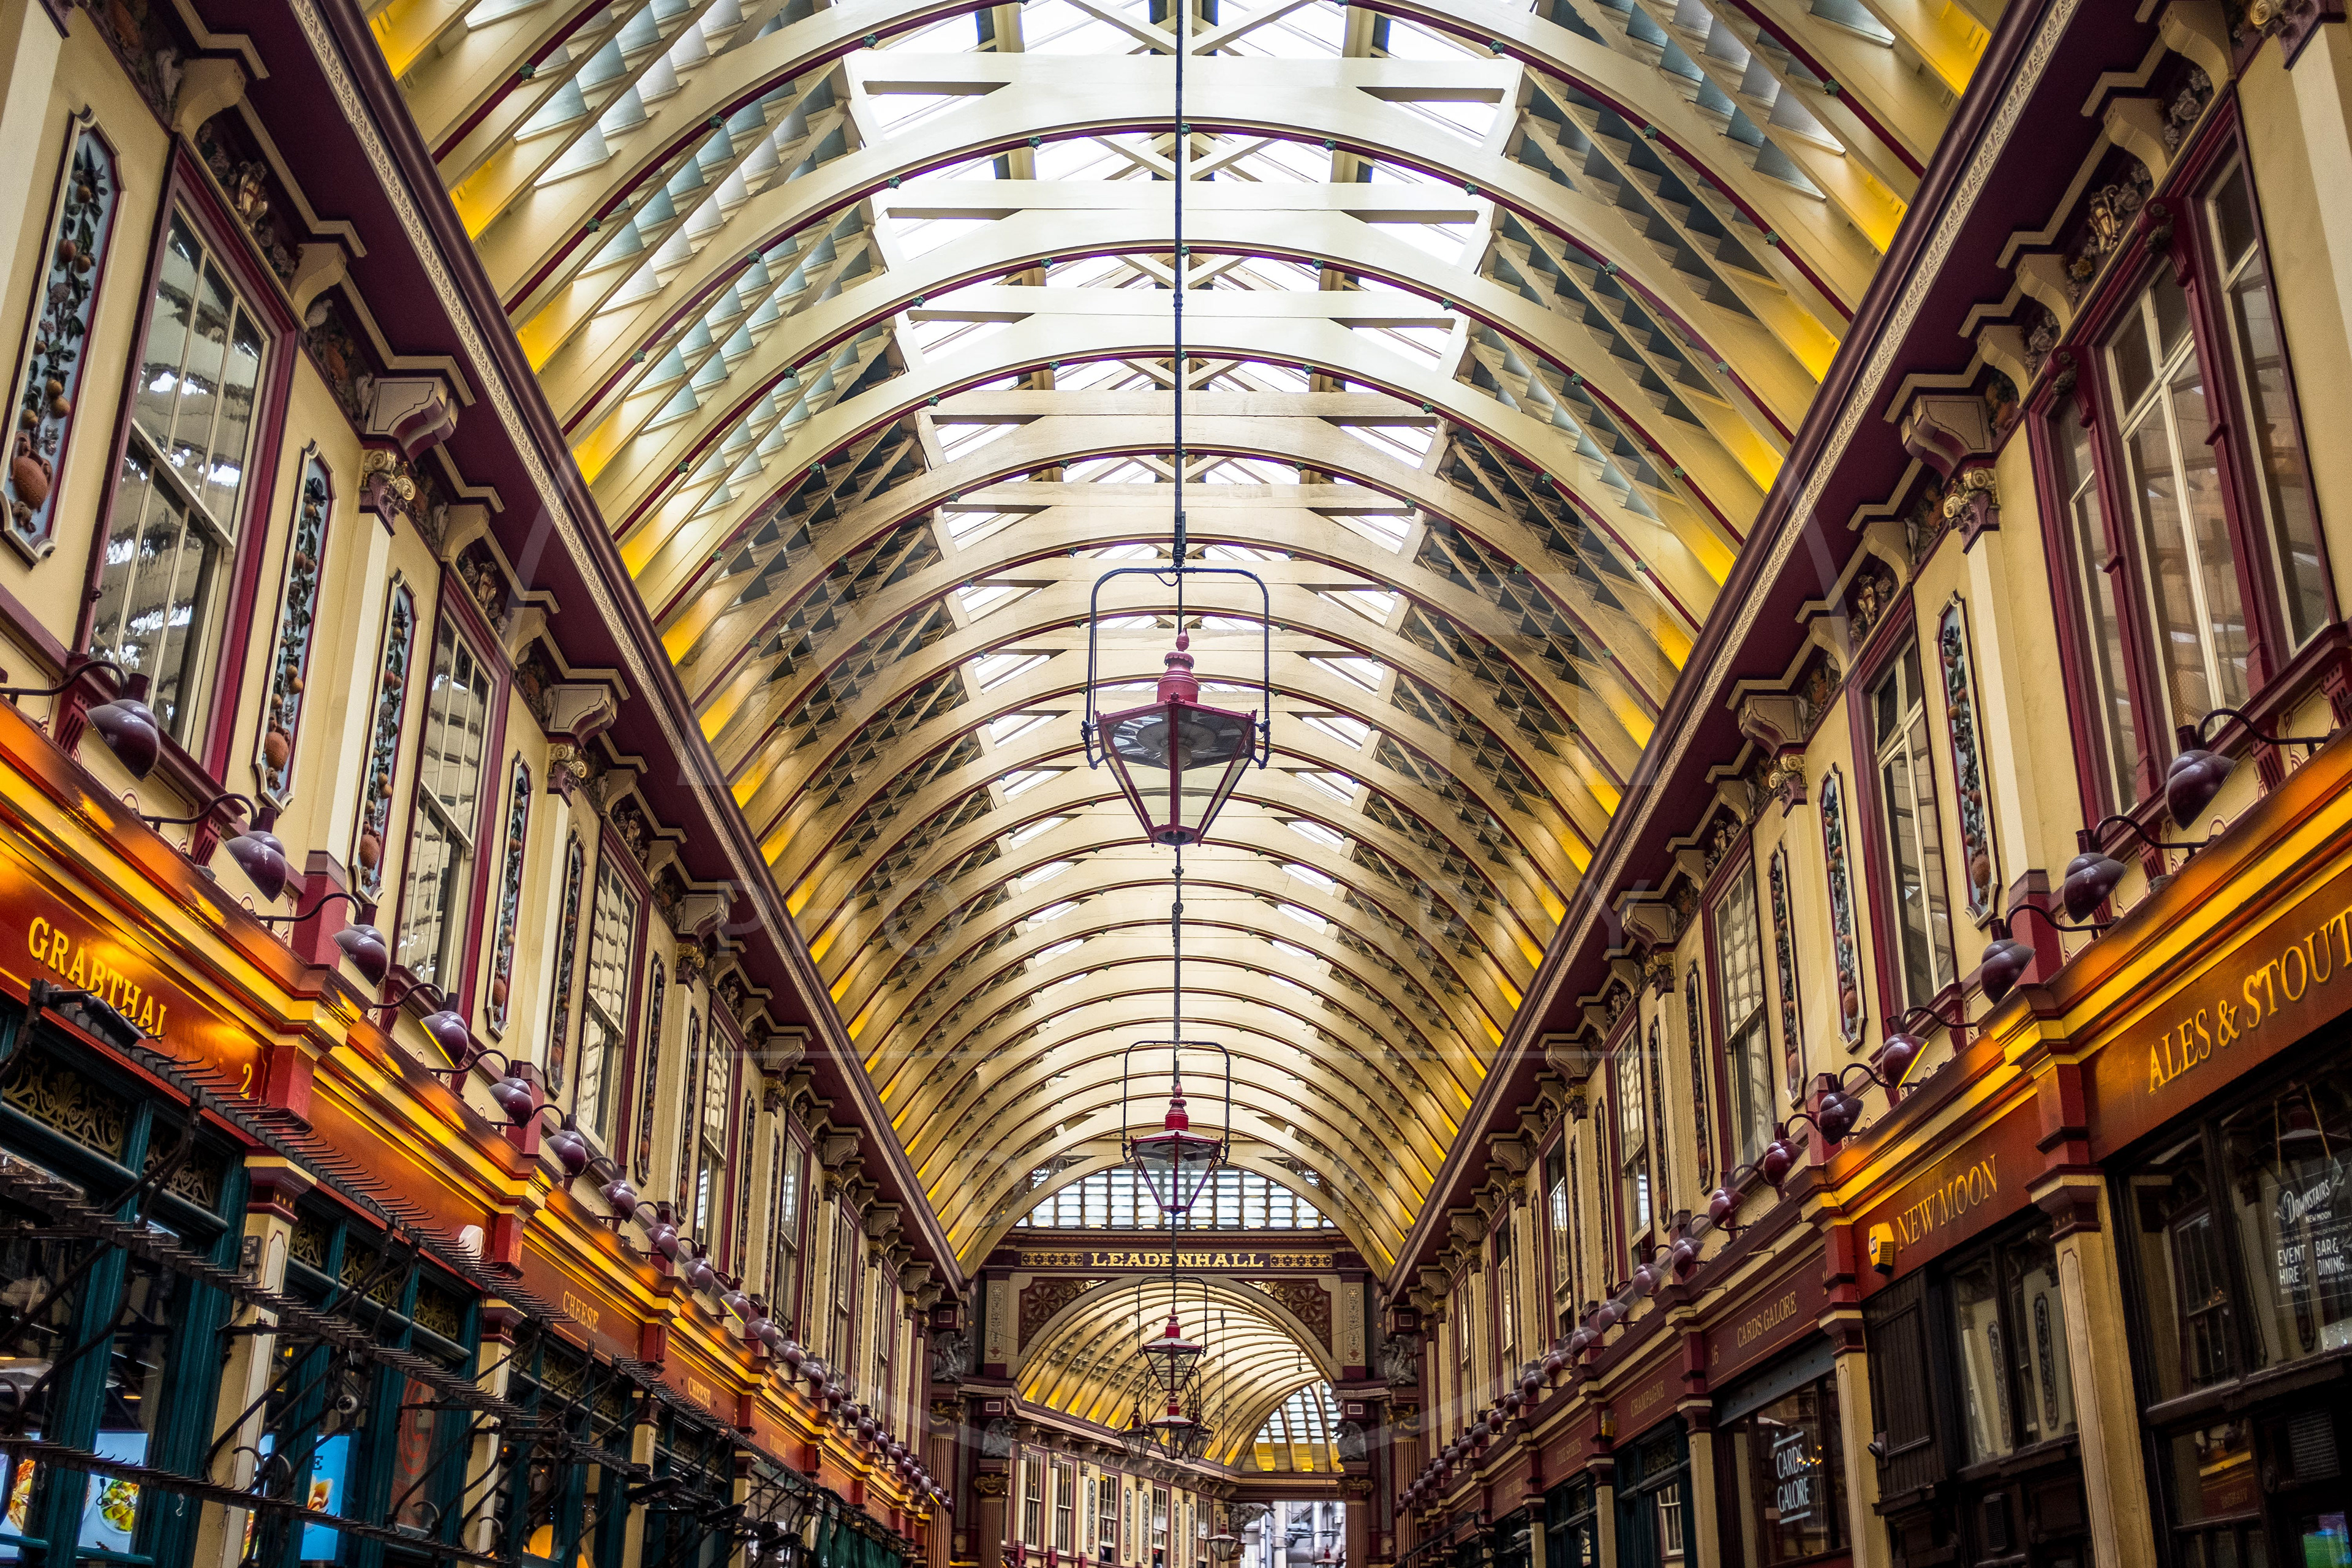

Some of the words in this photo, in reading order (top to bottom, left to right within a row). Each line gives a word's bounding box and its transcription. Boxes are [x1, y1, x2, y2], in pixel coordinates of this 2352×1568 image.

[28, 916, 167, 1041] GRABTHAI
[2148, 1008, 2212, 1095] ALES
[2218, 1000, 2241, 1047] &
[239, 1063, 252, 1099] 2
[1896, 1193, 1936, 1252] NEW
[1939, 1153, 1998, 1227] MOON
[2305, 1213, 2316, 1224] NEW
[2317, 1210, 2332, 1221] MOON
[1091, 1253, 1264, 1267] LEADENHALL
[2277, 1244, 2307, 1266] EVENT
[2317, 1256, 2345, 1276] DINING
[2278, 1265, 2300, 1285] HIRE
[563, 1291, 599, 1333] CHEESE
[1737, 1314, 1762, 1348] CARDS
[1763, 1291, 1797, 1332] GALORE
[1711, 1344, 1719, 1366] 16
[688, 1376, 710, 1409] CHEESE
[1777, 1444, 1804, 1479] CARDS
[1777, 1477, 1810, 1513] GALORE
